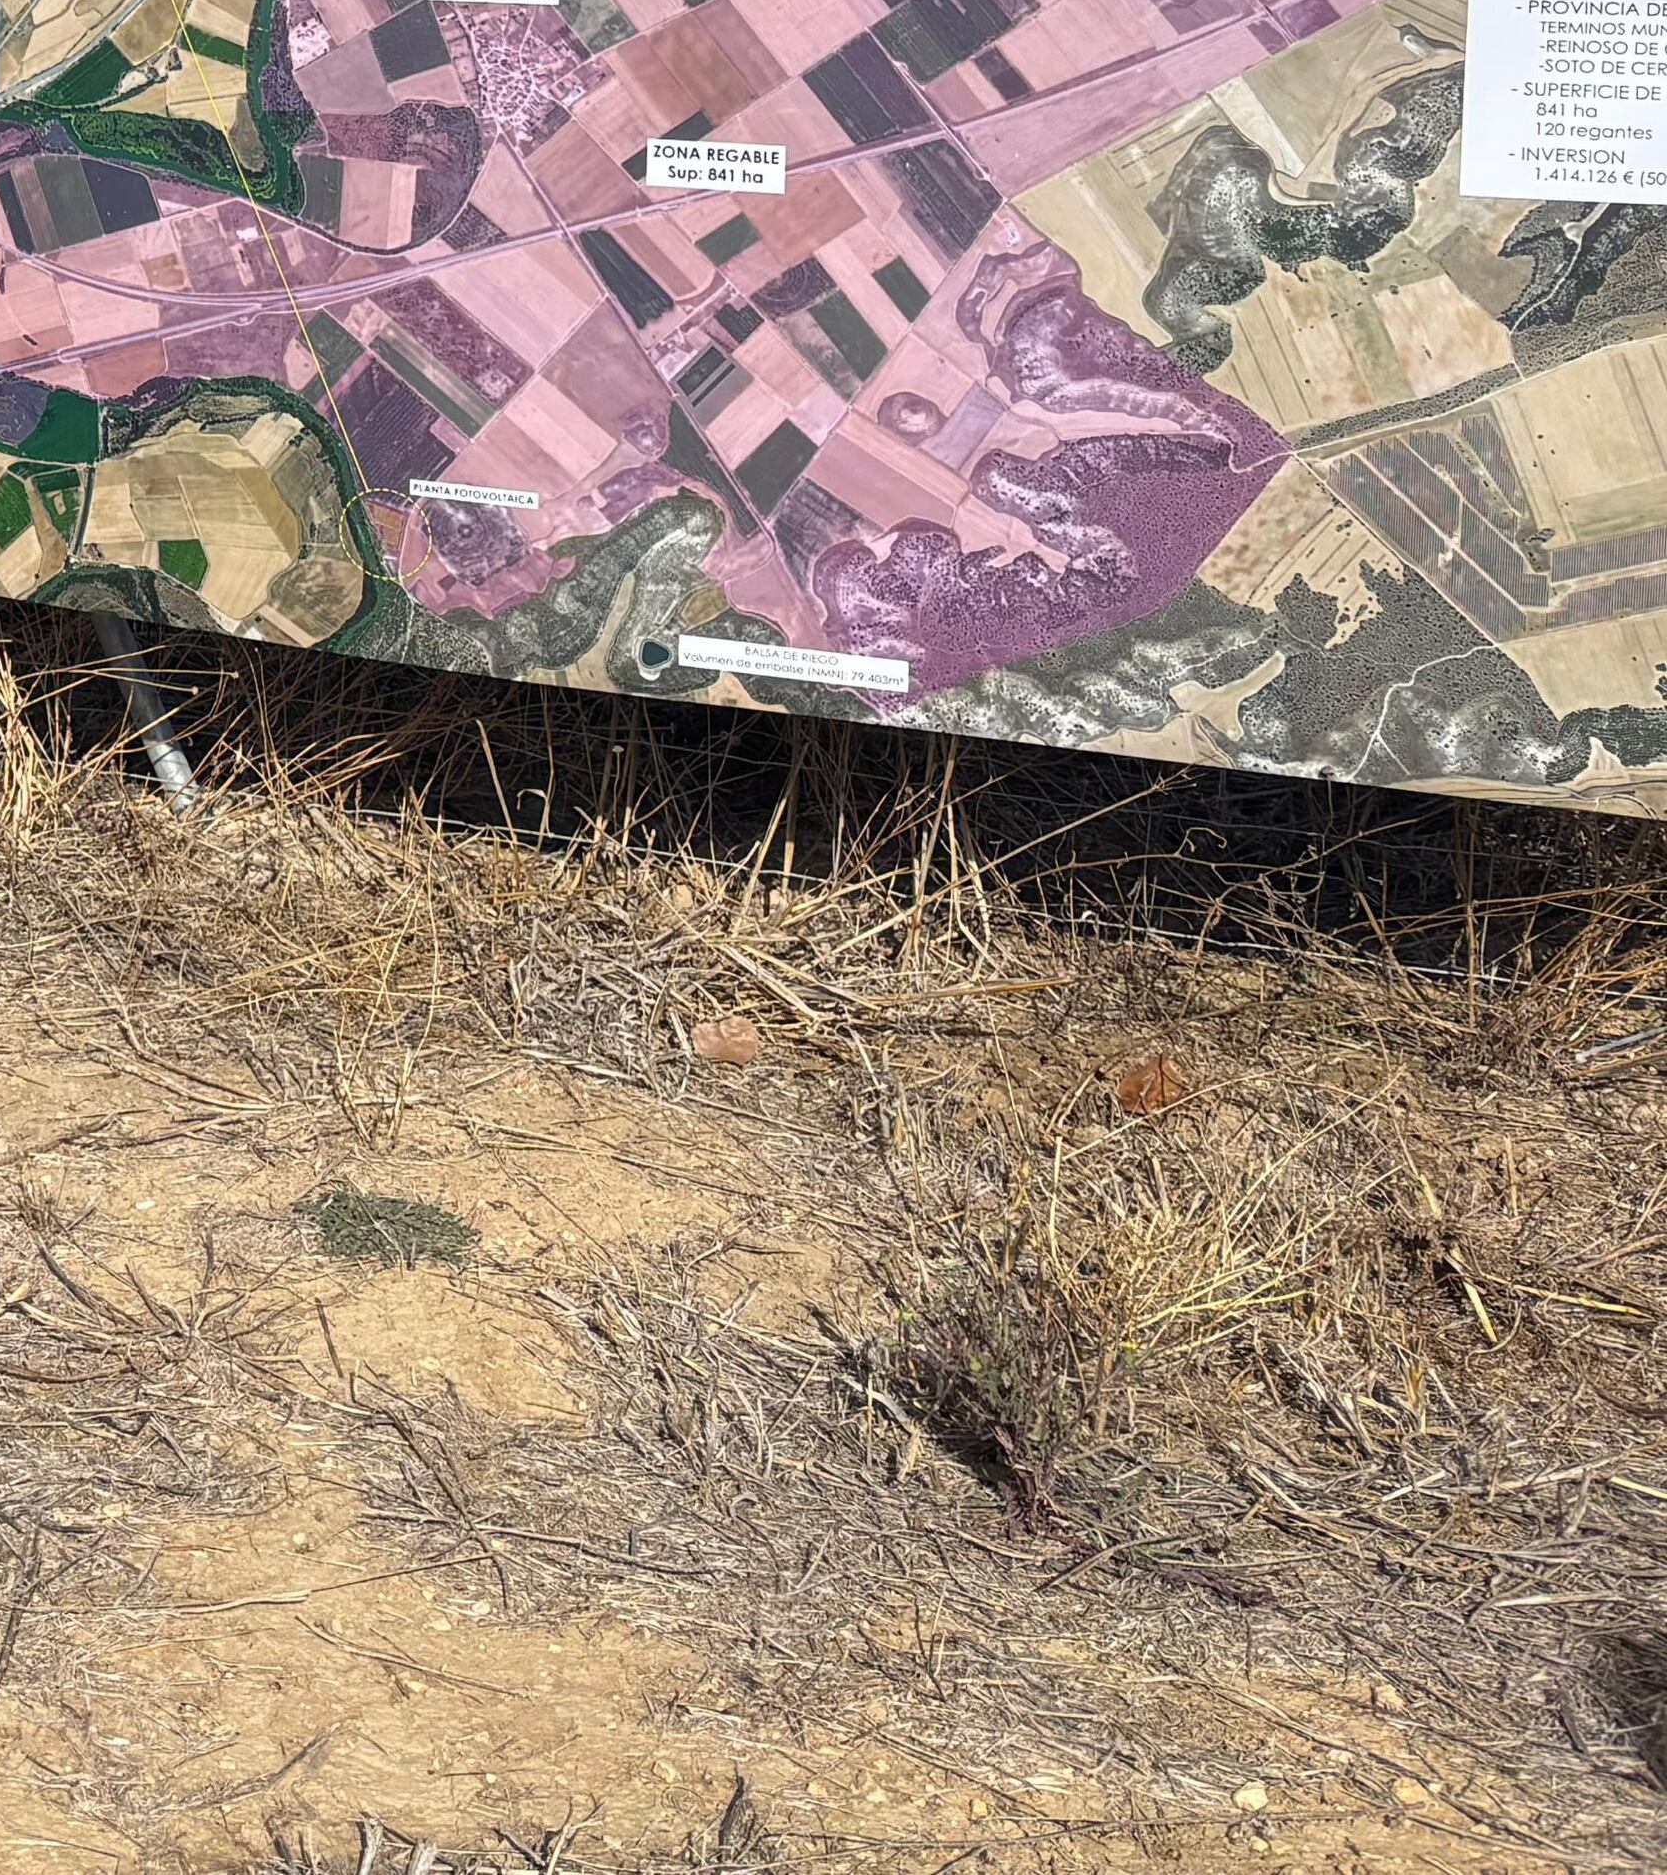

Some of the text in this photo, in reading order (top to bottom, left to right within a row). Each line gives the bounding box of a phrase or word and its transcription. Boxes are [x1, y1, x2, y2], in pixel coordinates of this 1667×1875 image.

[1529, 0, 1639, 16] PROVINCIA
[1539, 21, 1625, 36] TERMINOS
[1539, 39, 1628, 55] -REINOSO
[1635, 42, 1659, 56] DE
[1539, 59, 1595, 73] -SOTO
[1601, 61, 1625, 74] DE
[1523, 82, 1629, 99] SUPERFICIE
[1636, 86, 1660, 100] DE
[1536, 102, 1597, 118] 841 ha
[1537, 122, 1653, 141] 120 regantes
[653, 145, 779, 165] ZONA REGABLE
[1522, 147, 1625, 165] INVERSION
[668, 166, 763, 184] Sup: 841 ha
[1536, 167, 1617, 184] 1.414.126
[1623, 170, 1634, 185] €
[414, 484, 534, 504] PLANTA FOTOVOLTAICA
[683, 652, 733, 665] Volumen
[736, 660, 751, 669] de
[745, 646, 838, 665] BALSA DE RIEGO
